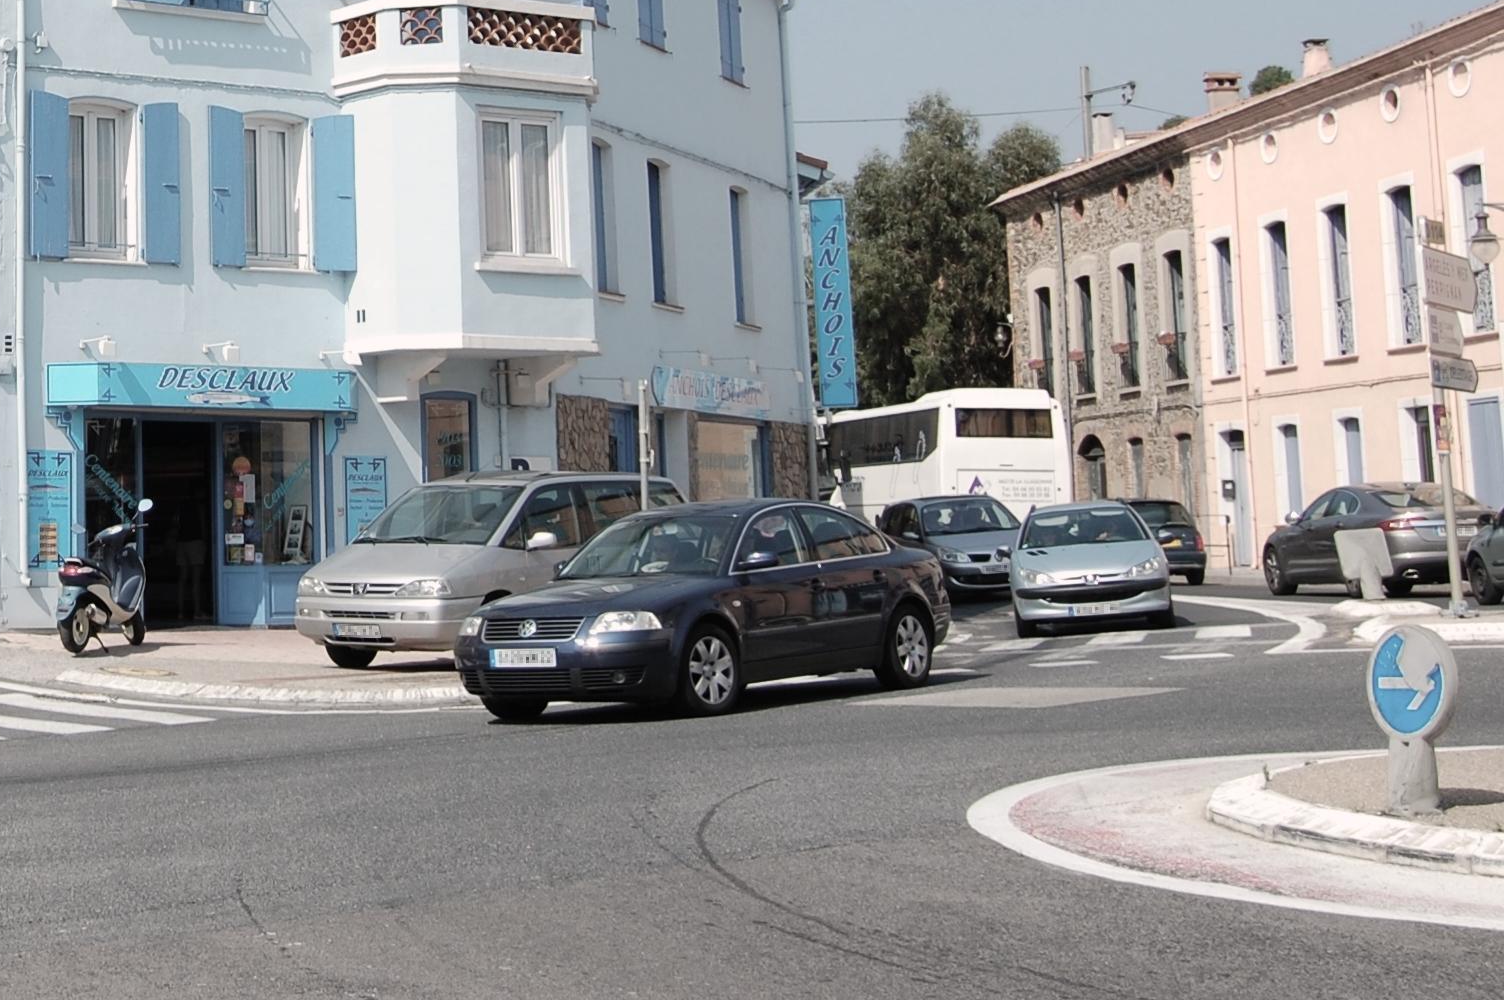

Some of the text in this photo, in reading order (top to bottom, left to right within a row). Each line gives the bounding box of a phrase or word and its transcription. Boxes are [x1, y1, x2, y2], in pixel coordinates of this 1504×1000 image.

[818, 225, 846, 379] ANCHOIS
[157, 366, 295, 392] DESCLAUX
[670, 375, 711, 398] ANCHOIS
